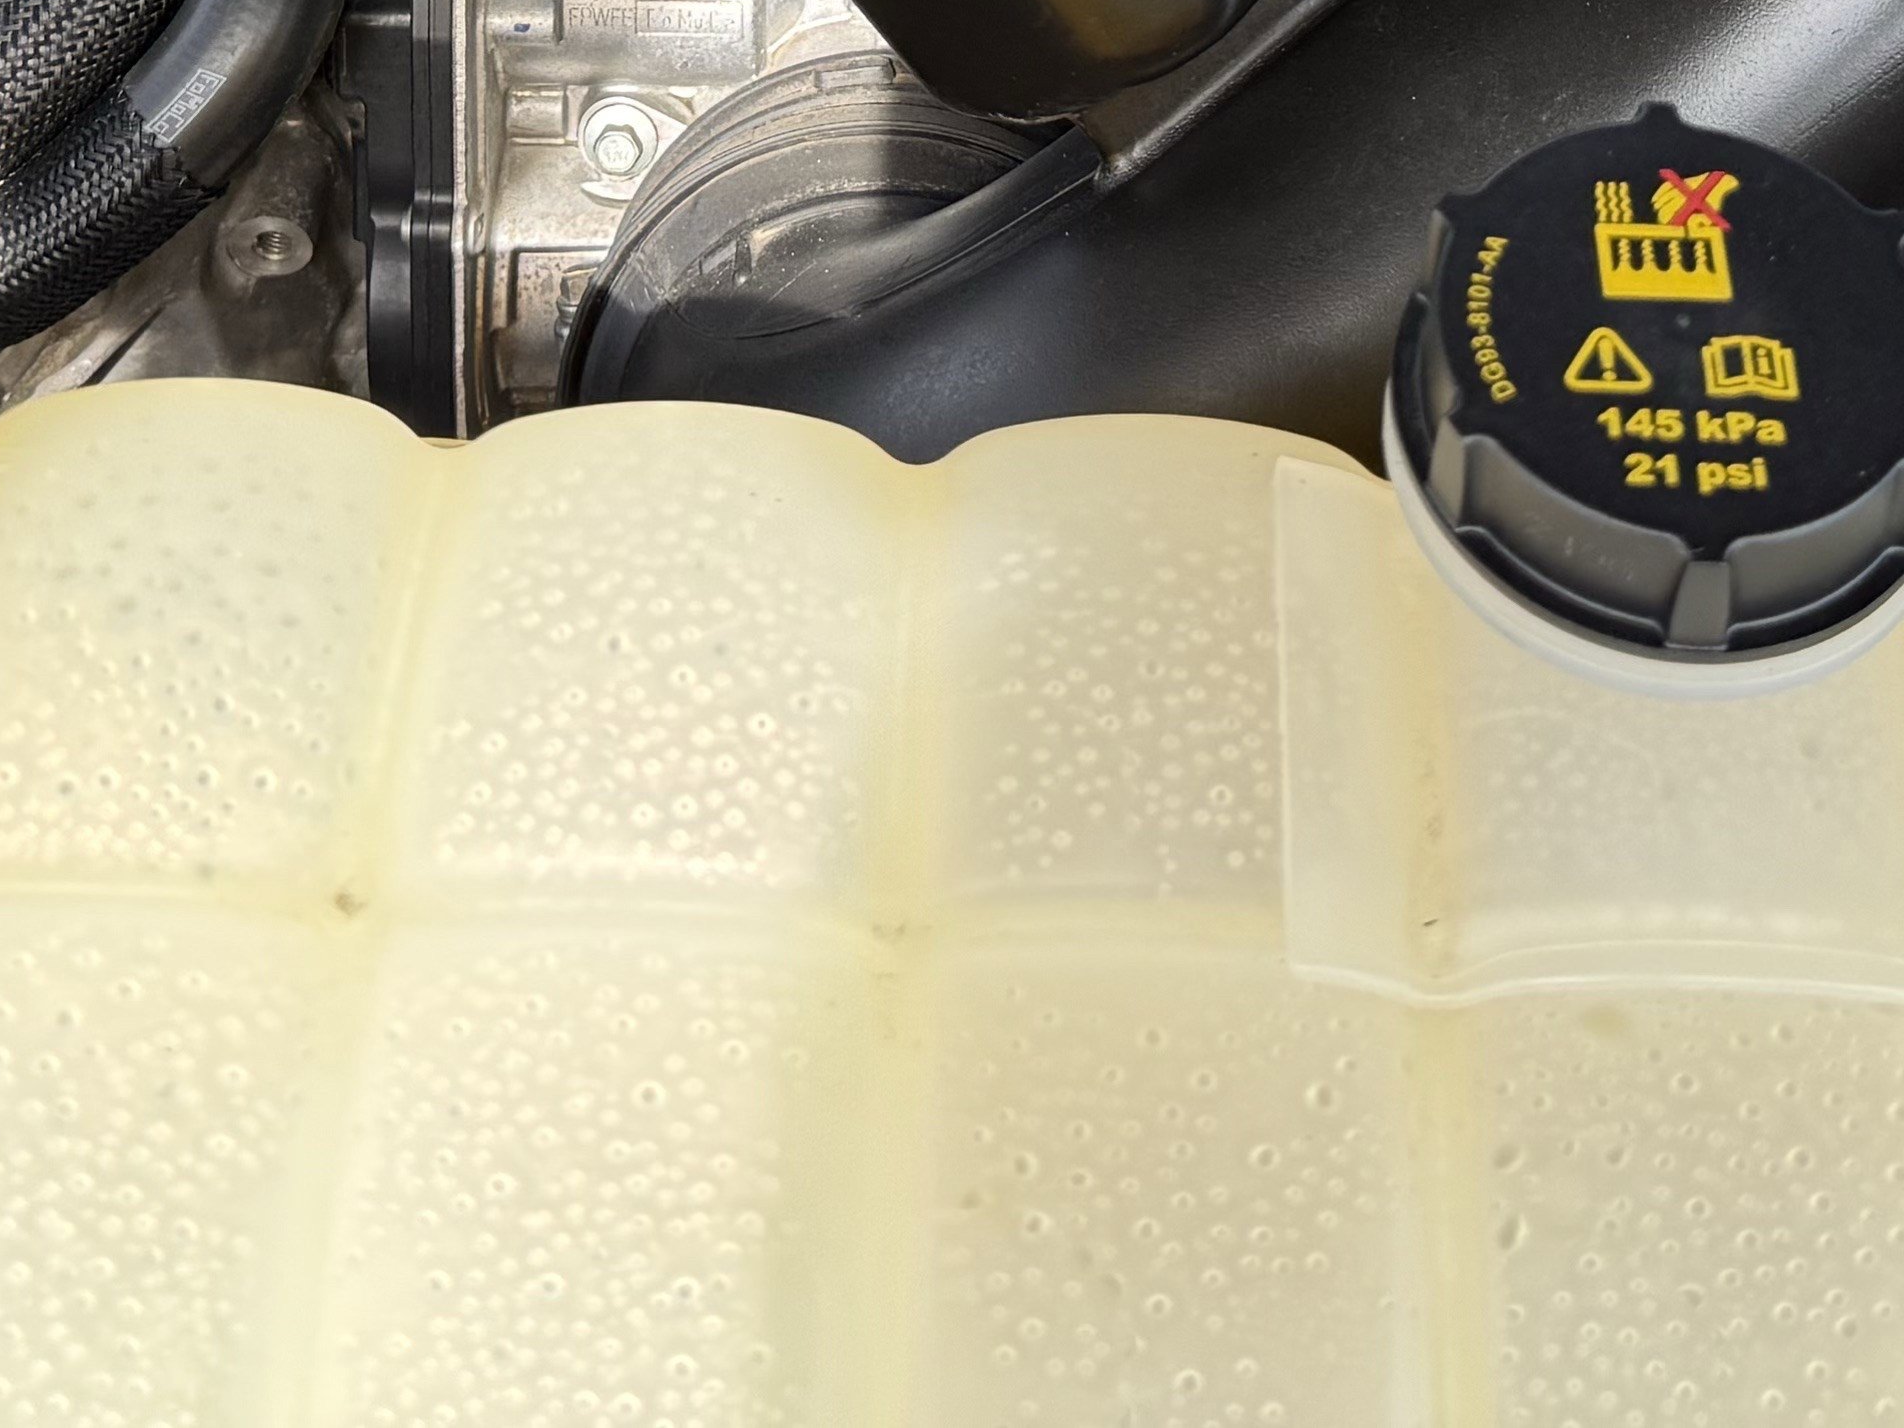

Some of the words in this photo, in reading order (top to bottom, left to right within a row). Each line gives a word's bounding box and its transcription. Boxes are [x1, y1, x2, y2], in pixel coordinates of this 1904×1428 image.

[1596, 407, 1683, 441] 145
[1696, 410, 1787, 443] kPa
[1624, 454, 1680, 487] 21
[1697, 457, 1768, 493] psi
